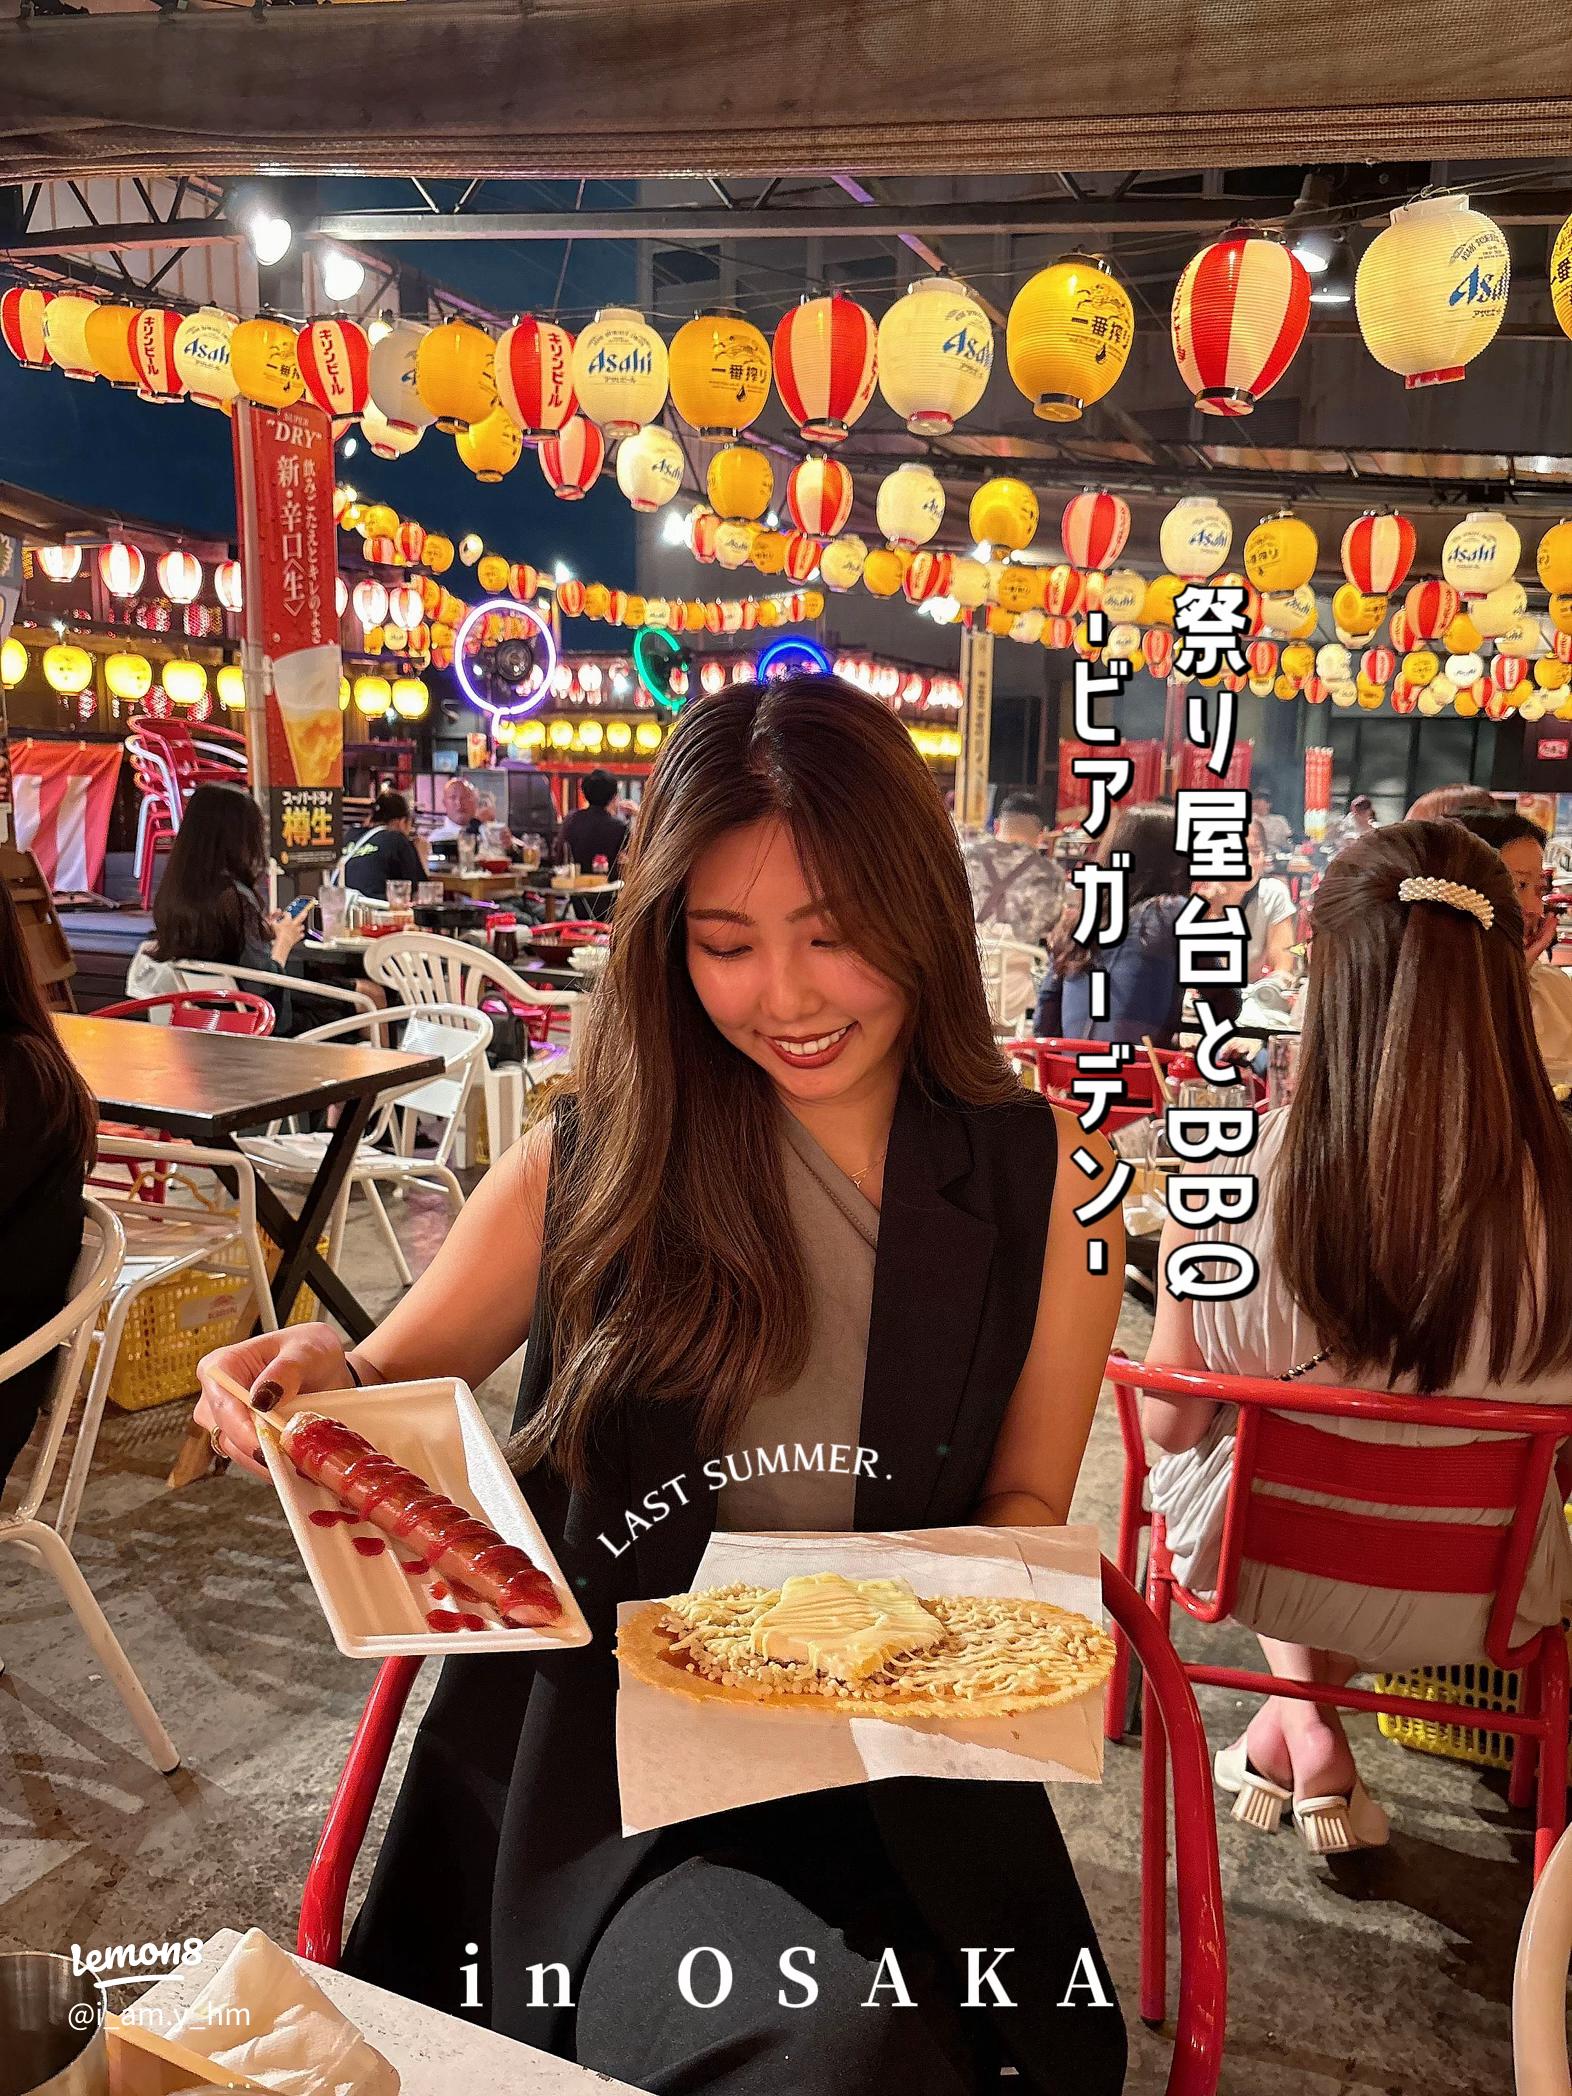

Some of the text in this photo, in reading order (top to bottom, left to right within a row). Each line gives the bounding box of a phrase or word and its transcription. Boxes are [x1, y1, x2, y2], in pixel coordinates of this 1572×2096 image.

[141, 316, 159, 376] キリンビール
[319, 328, 345, 395] キリンビール
[547, 332, 565, 408] キリンビール
[588, 347, 652, 375] Asahi
[1447, 544, 1497, 562] Asahi
